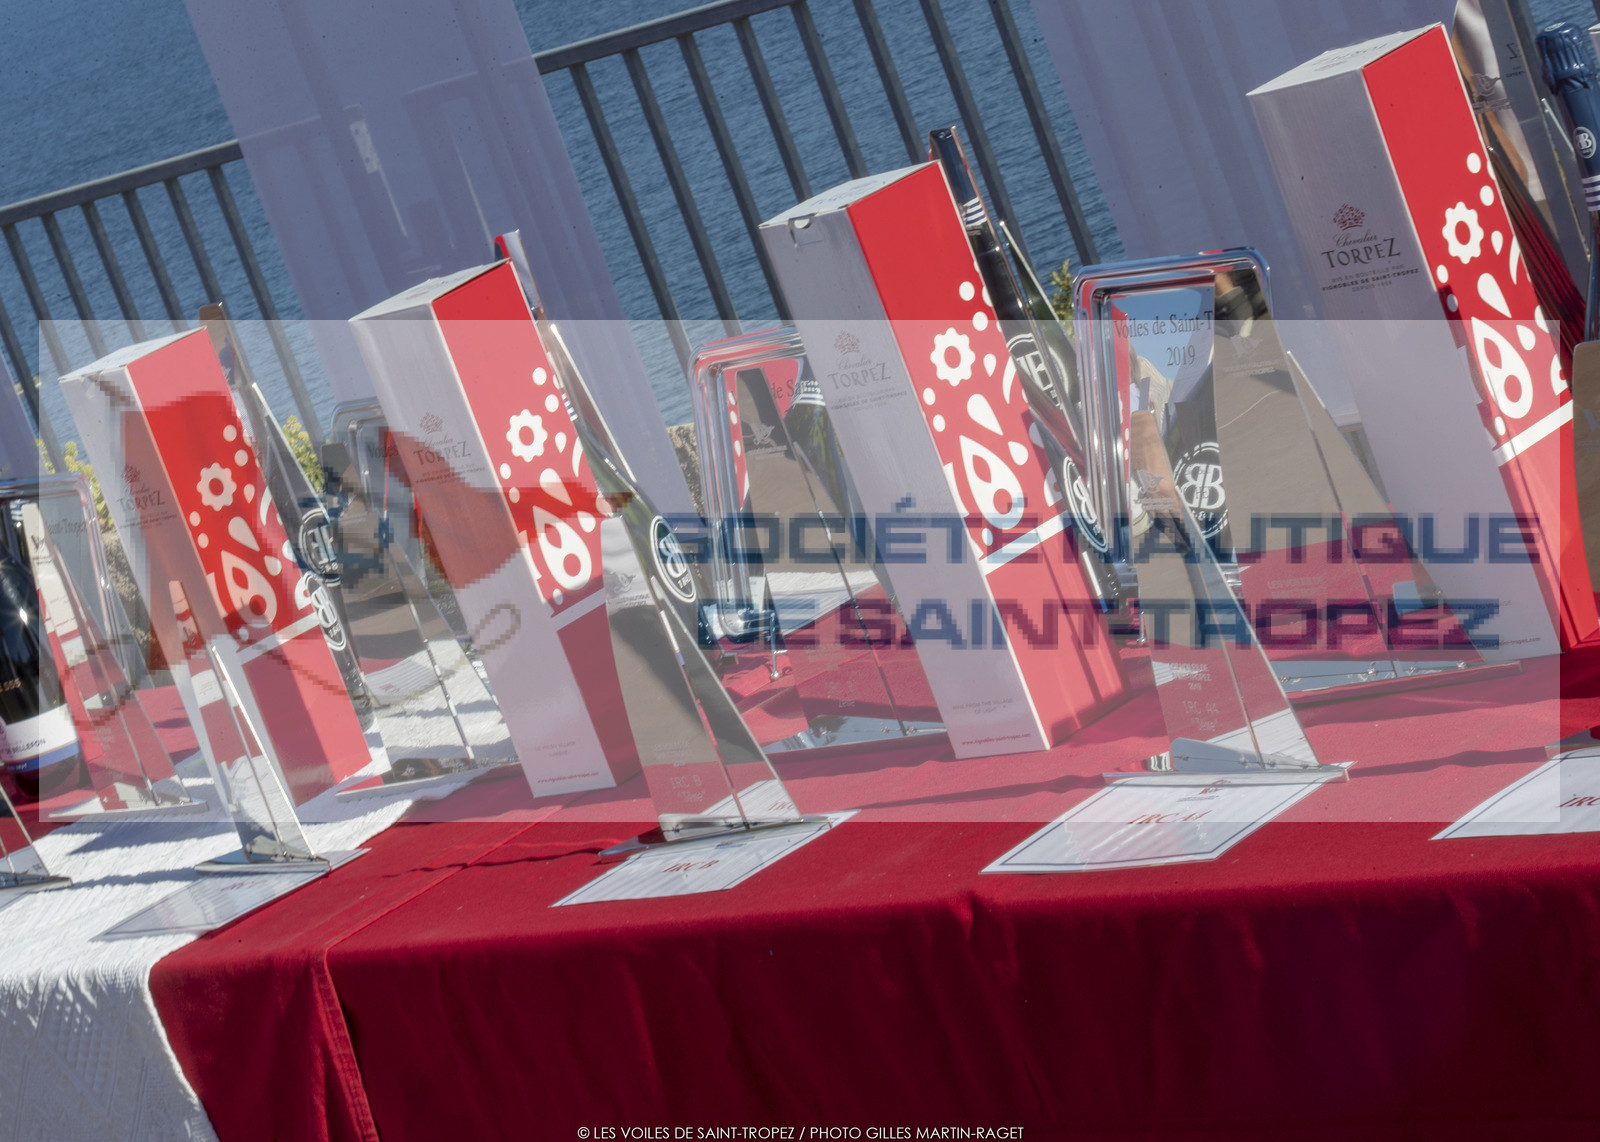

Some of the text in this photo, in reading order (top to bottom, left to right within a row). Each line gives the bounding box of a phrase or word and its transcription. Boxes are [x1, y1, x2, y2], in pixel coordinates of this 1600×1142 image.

[1320, 237, 1401, 269] TORPEZ
[1114, 317, 1149, 339] Voiles
[1152, 314, 1166, 335] de
[1165, 344, 1196, 367] 2019
[826, 362, 892, 390] TORPEZ
[412, 441, 473, 465] TORPEZ
